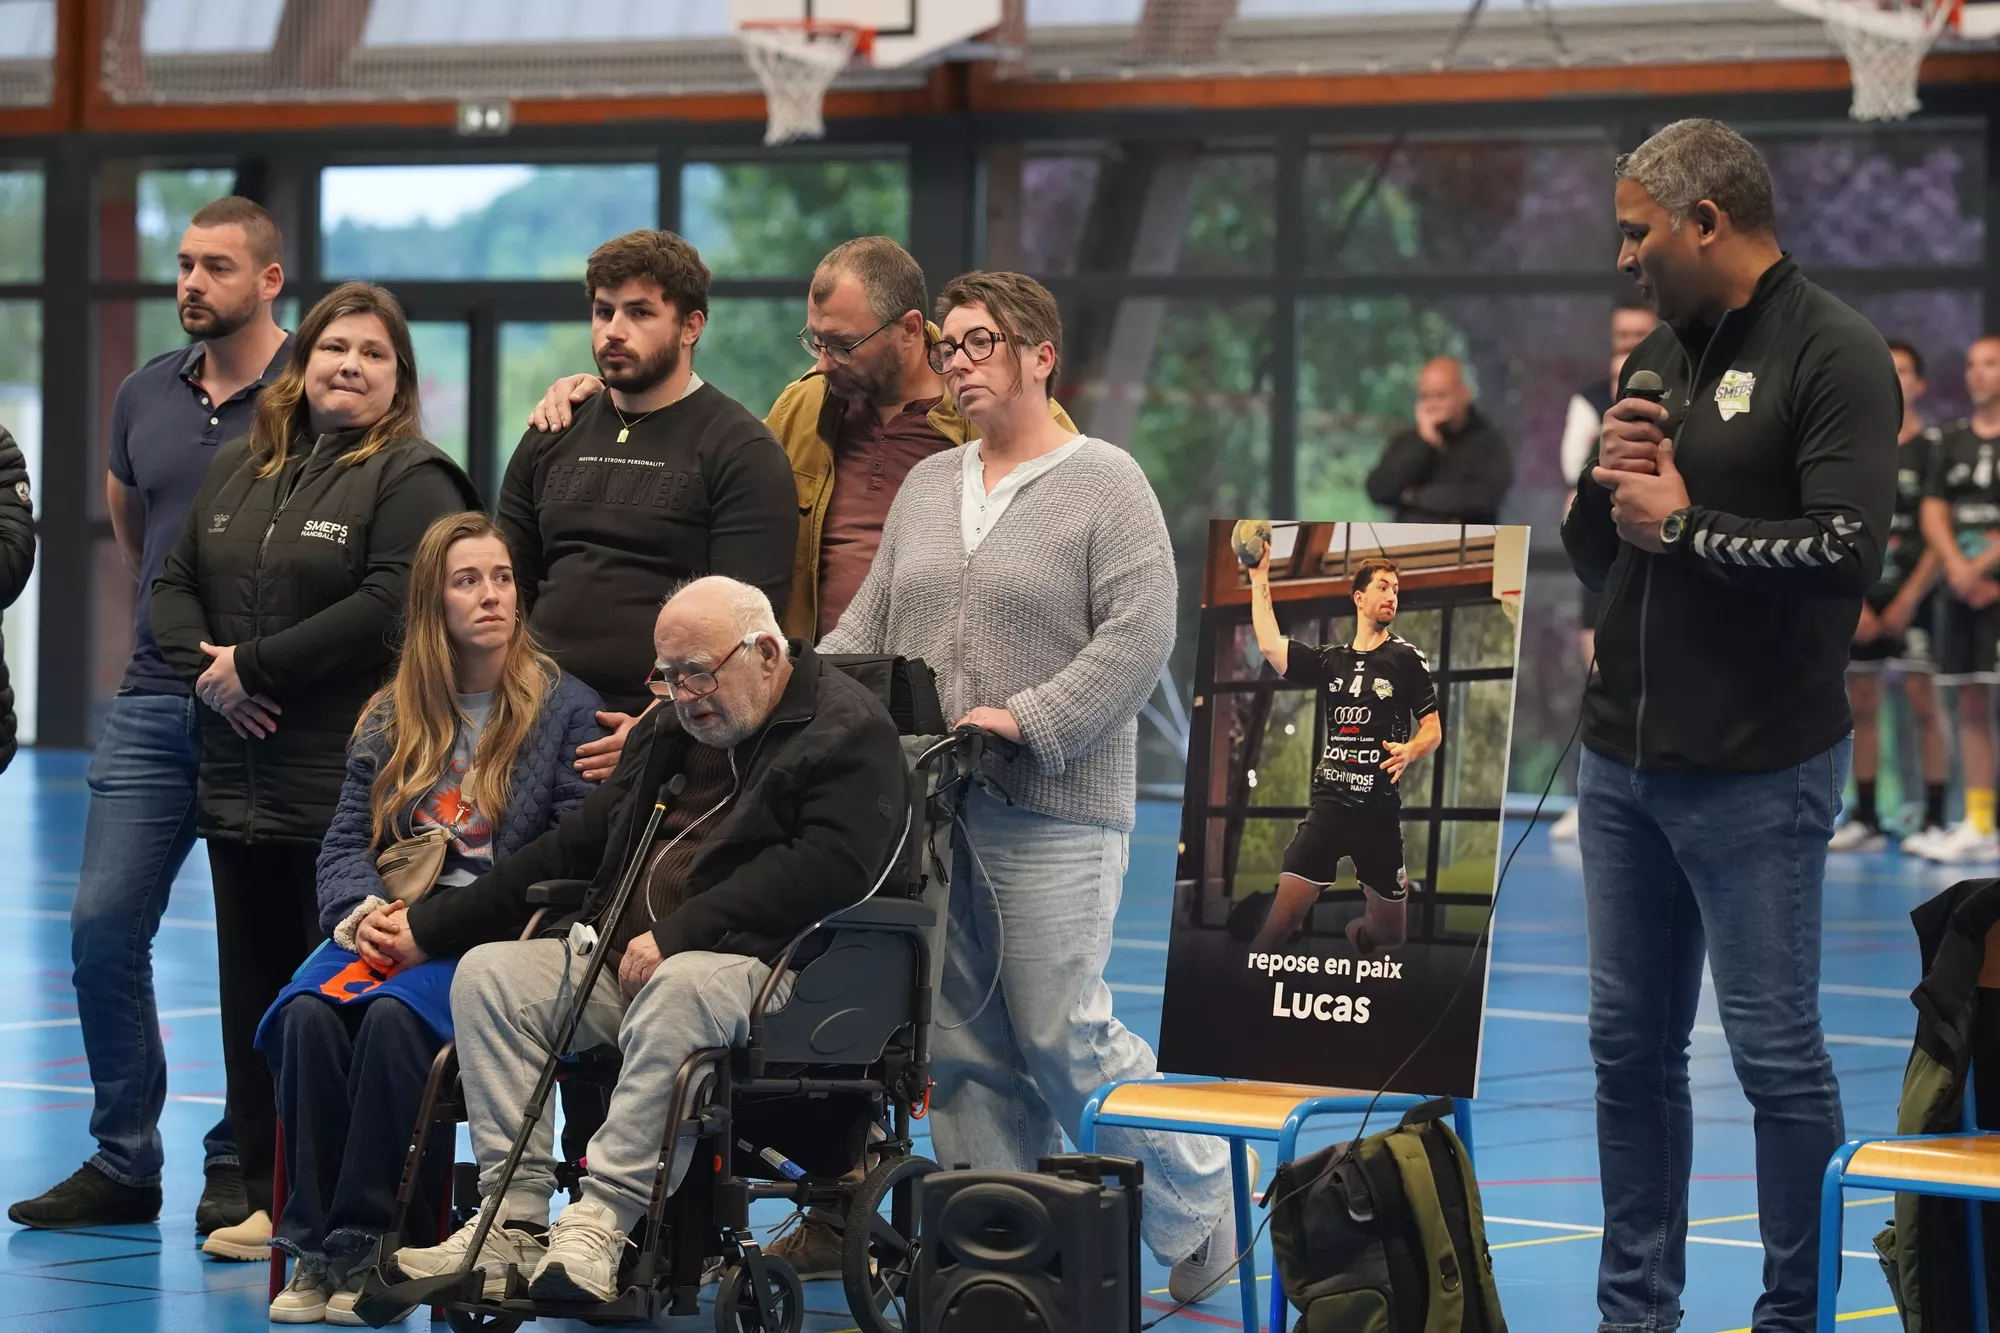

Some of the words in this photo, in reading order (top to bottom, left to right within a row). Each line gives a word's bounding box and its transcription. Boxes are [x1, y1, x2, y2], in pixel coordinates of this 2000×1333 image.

[1716, 384, 1754, 400] SMEPS
[627, 459, 665, 467] PERSONALITY
[542, 466, 602, 502] FEED
[303, 520, 348, 537] SMEPS
[300, 530, 335, 541] HANDBALL
[337, 537, 346, 545] 54
[1349, 675, 1363, 698] 4
[1323, 768, 1374, 786] TECHNIPOSE
[1350, 784, 1372, 793] NANCY
[1248, 952, 1320, 977] repose
[1324, 957, 1351, 975] en
[1356, 955, 1403, 983] paix
[1272, 981, 1372, 1024] Lucas
